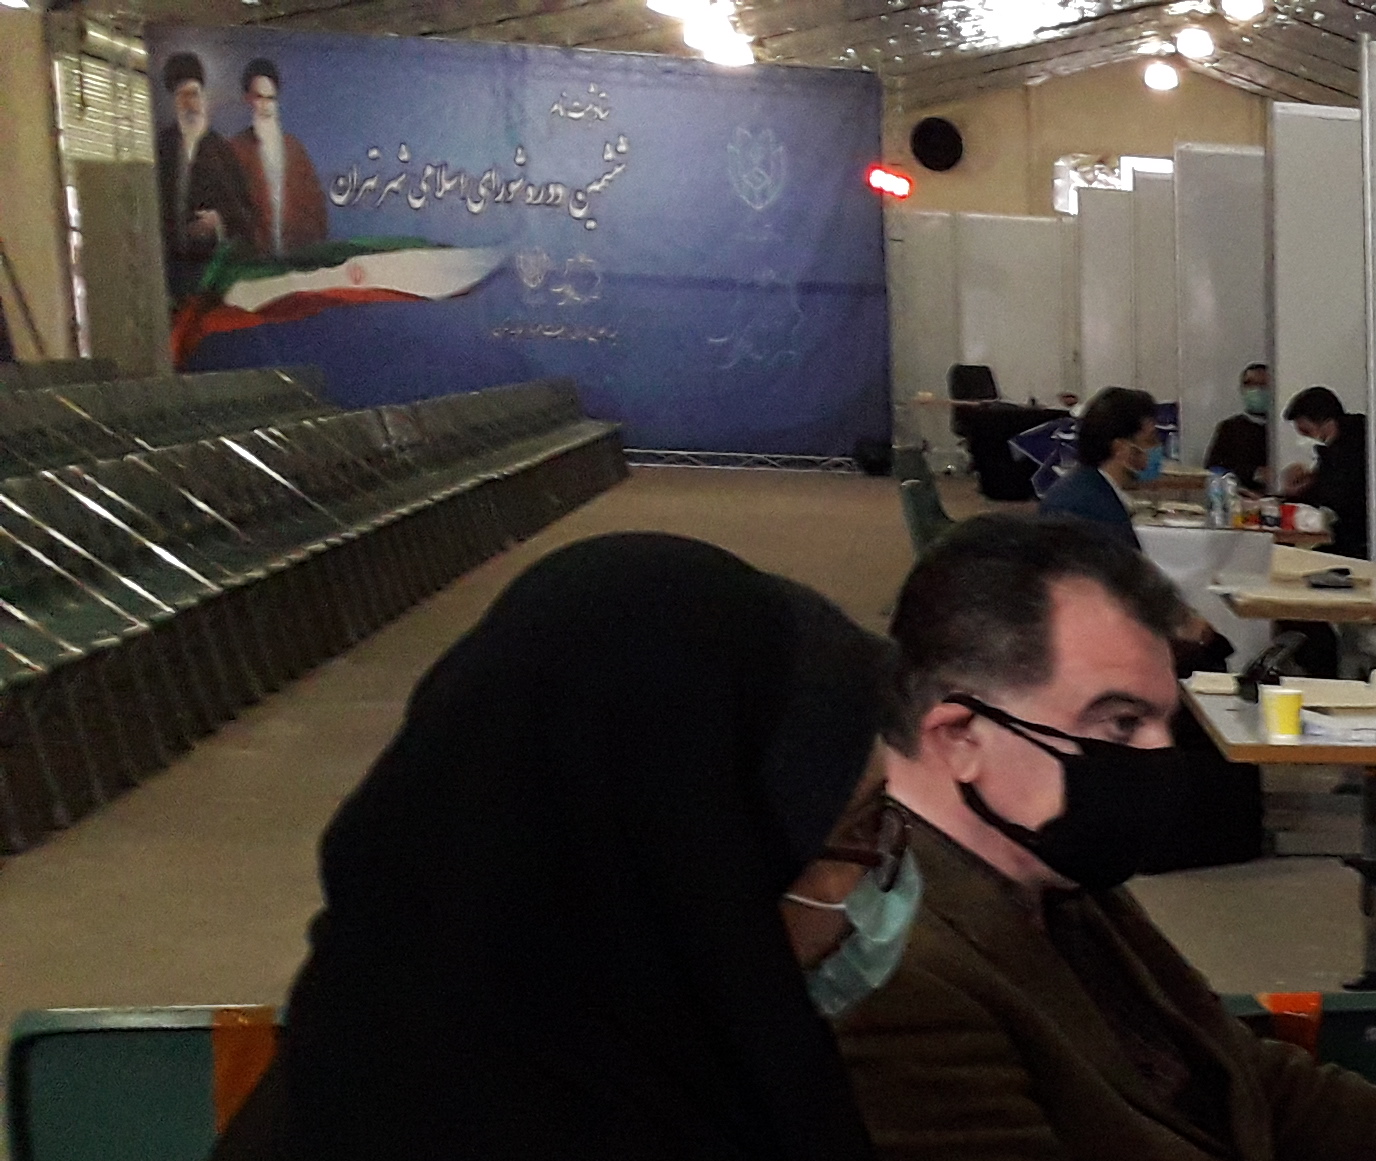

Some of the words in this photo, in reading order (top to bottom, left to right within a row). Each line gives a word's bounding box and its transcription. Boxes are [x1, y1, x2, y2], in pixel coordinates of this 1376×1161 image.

[329, 145, 380, 207] تهران
[406, 163, 467, 210] اسلامی
[465, 143, 525, 215] شورای
[567, 133, 630, 231] ششمین
